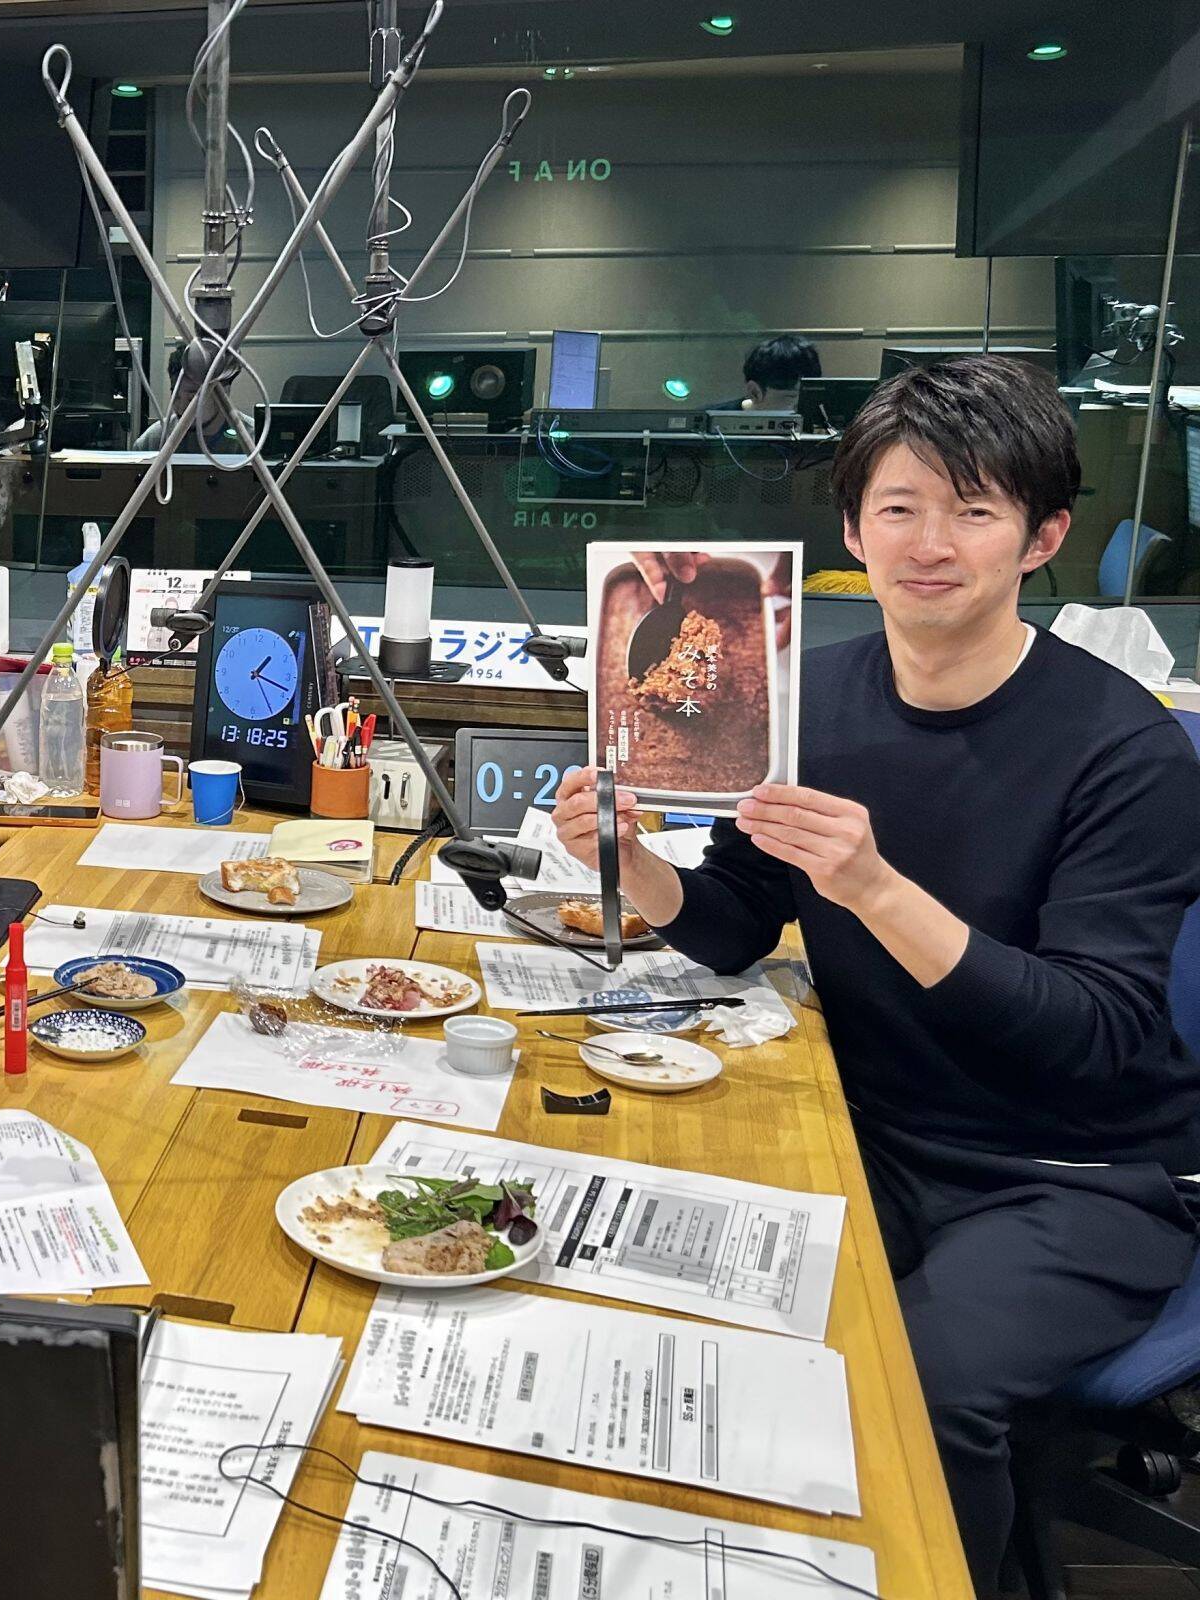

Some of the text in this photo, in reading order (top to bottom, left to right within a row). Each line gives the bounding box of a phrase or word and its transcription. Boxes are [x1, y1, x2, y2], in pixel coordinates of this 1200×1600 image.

[166, 577, 182, 588] 12
[675, 644, 702, 718] みそ本
[221, 725, 288, 748] 13:18:25
[476, 762, 583, 806] 0:2
